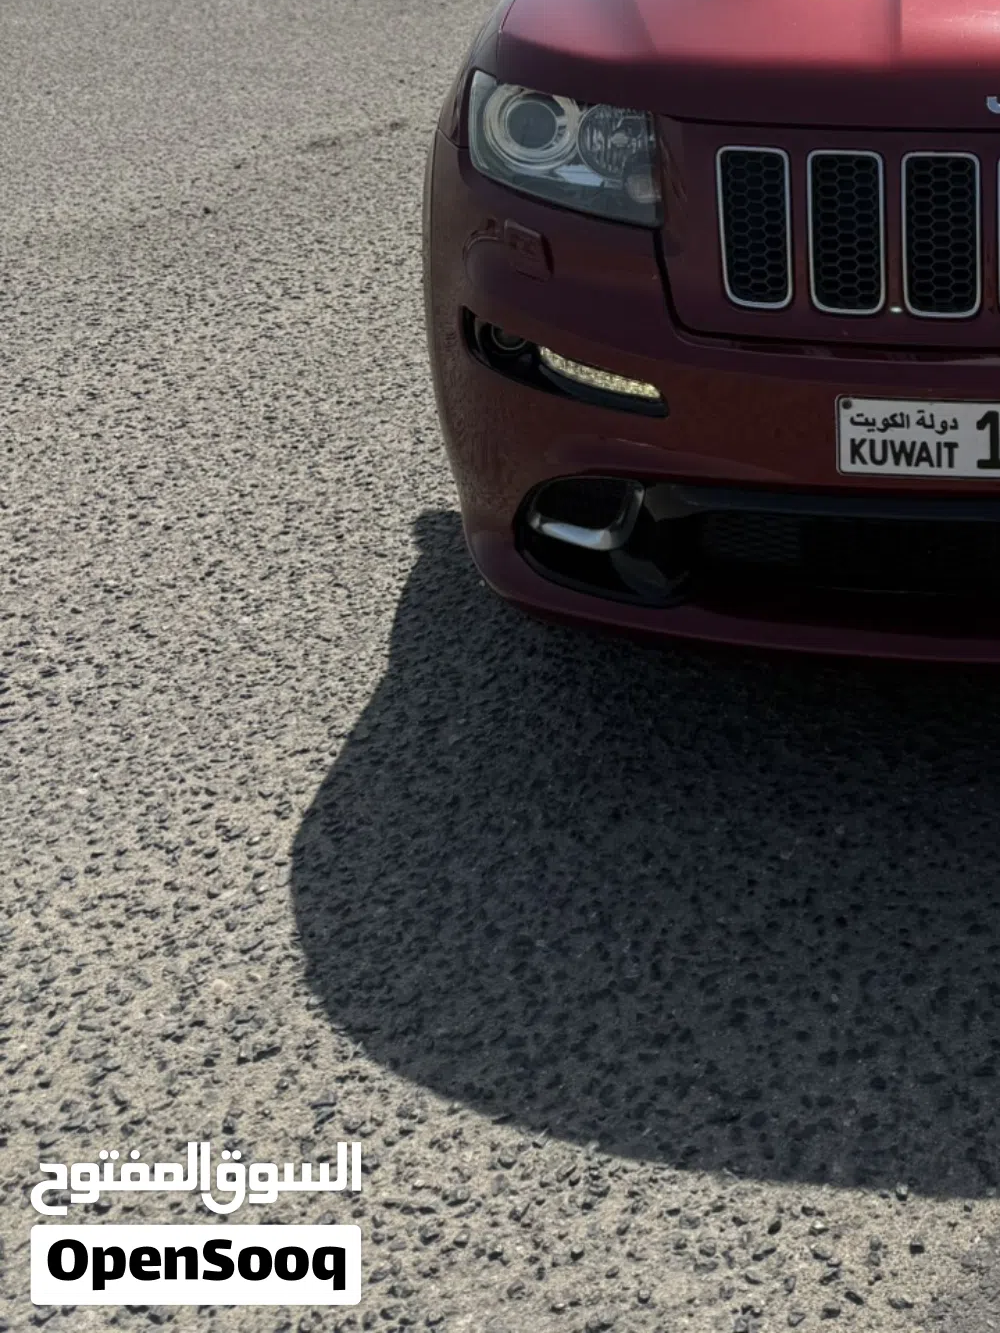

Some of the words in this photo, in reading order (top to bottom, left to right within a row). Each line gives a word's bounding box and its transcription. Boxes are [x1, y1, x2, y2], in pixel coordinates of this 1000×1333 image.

[849, 411, 911, 433] الكويت
[915, 410, 959, 435] دولة
[849, 438, 959, 468] KUWAIT
